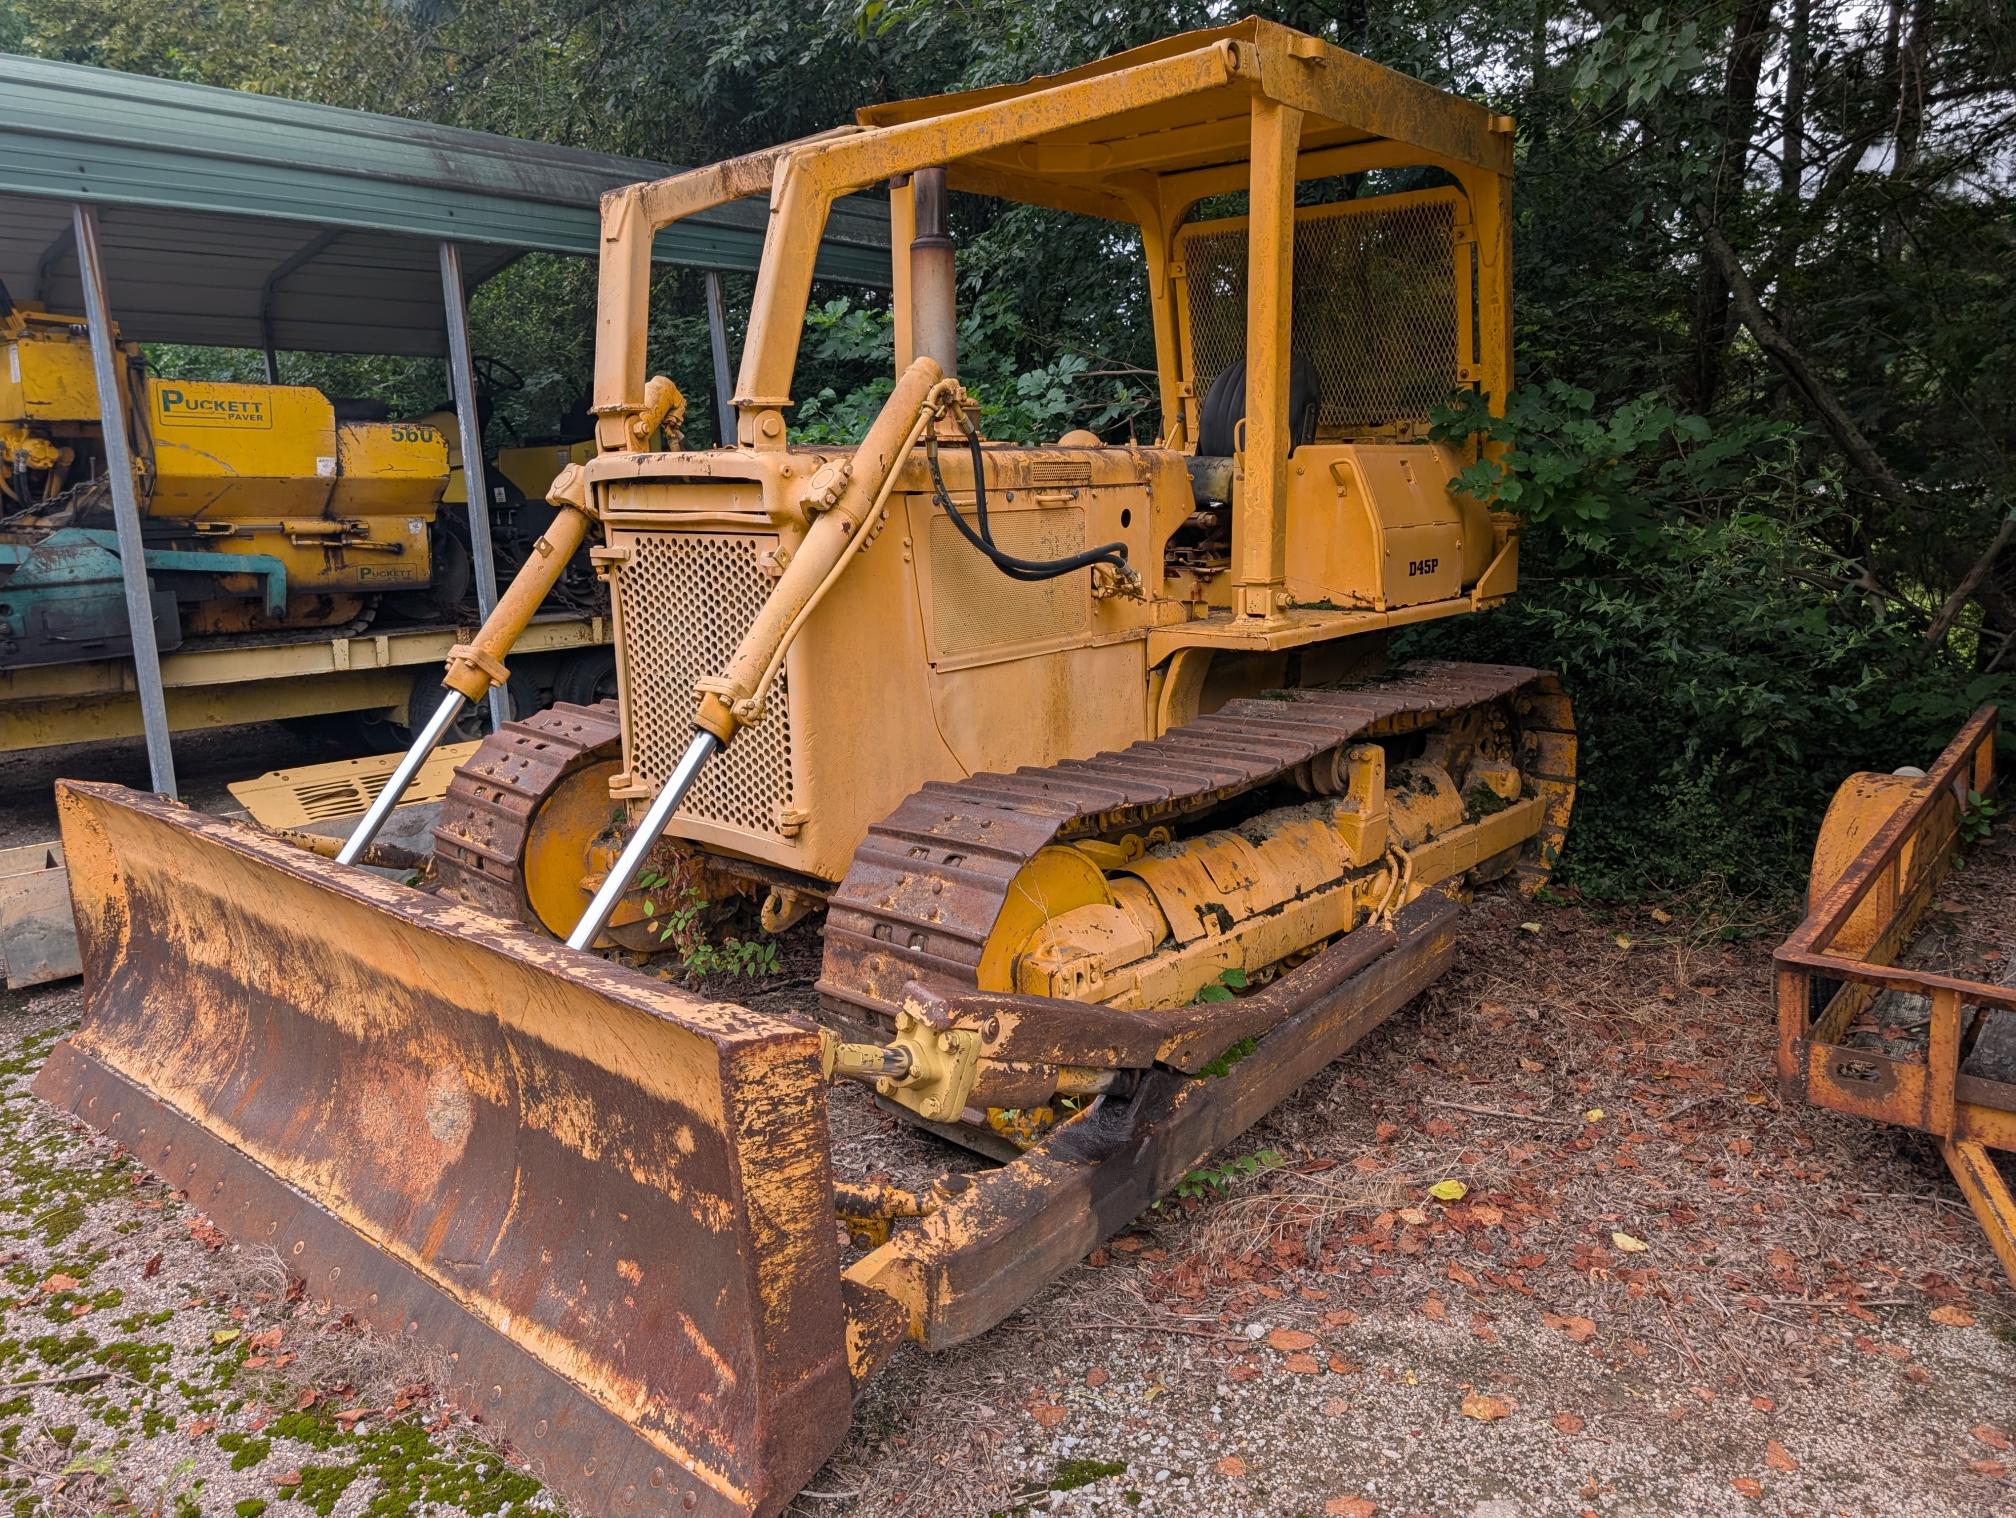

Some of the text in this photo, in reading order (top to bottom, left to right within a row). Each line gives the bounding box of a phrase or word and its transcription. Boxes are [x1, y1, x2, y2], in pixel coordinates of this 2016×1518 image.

[161, 389, 263, 413] PUCKETT
[228, 413, 263, 421] PAVER
[1408, 558, 1439, 577] D45P
